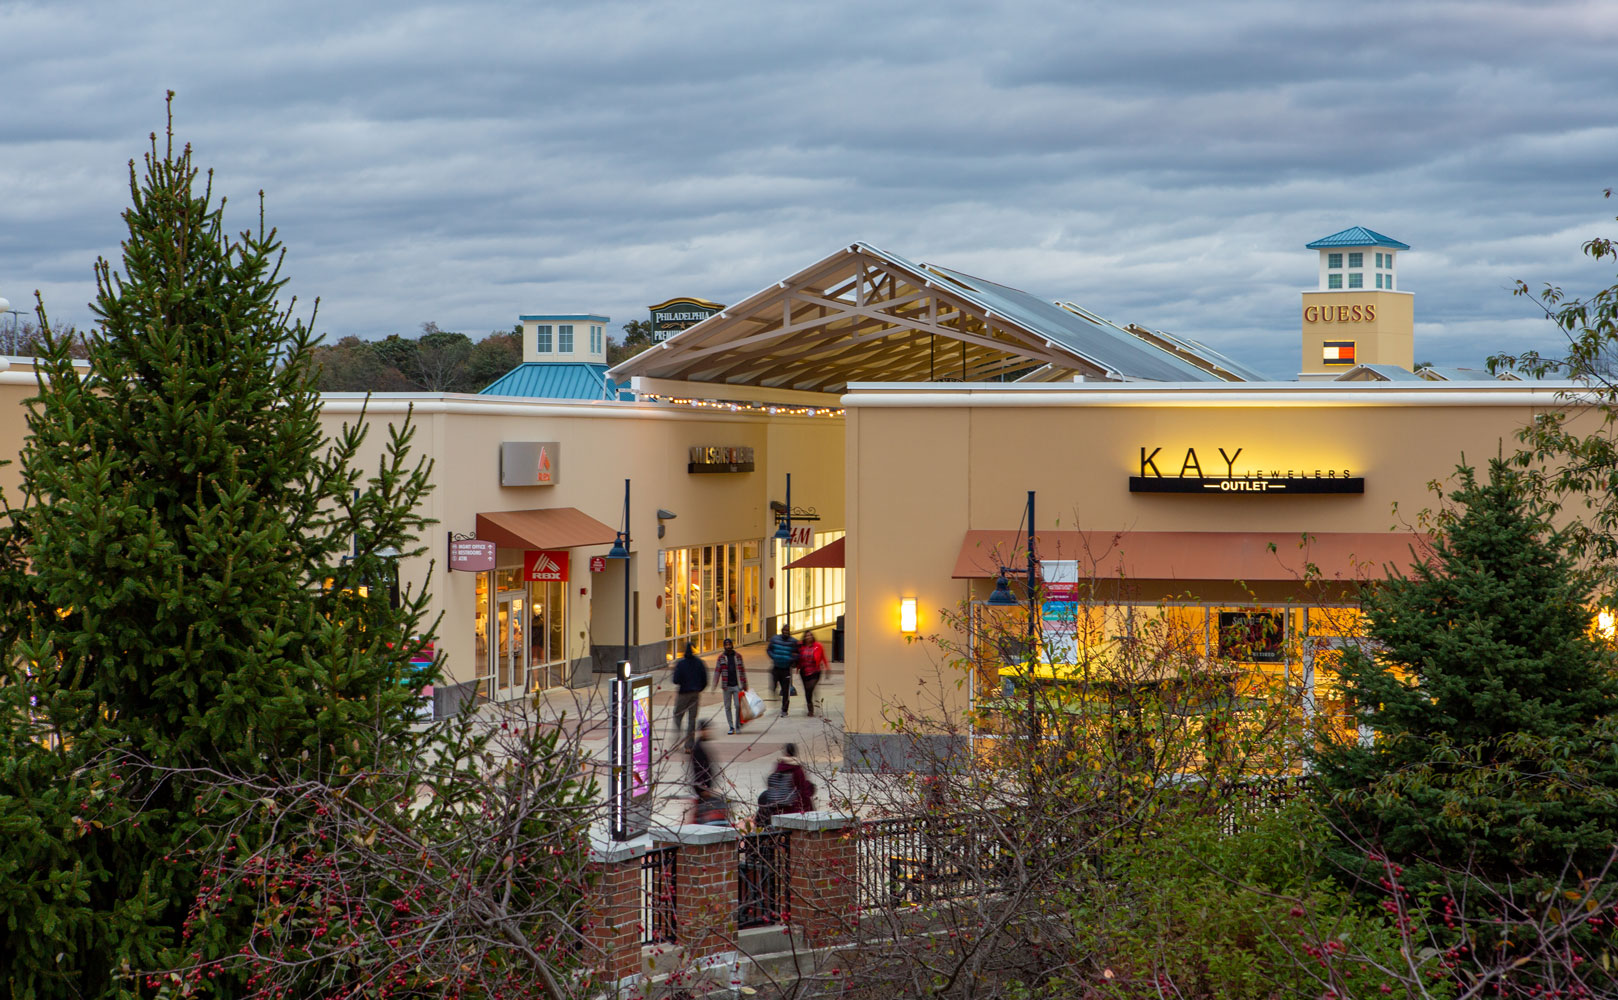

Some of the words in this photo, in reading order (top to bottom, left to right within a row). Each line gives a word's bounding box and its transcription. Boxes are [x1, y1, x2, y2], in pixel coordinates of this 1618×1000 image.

[656, 312, 710, 323] PHILADELPHIA
[1304, 304, 1376, 323] GUESS
[1140, 447, 1243, 479] KAY
[1243, 469, 1351, 479] JEWELERS
[1220, 480, 1269, 491] OUTLET
[532, 572, 561, 580] RBX
